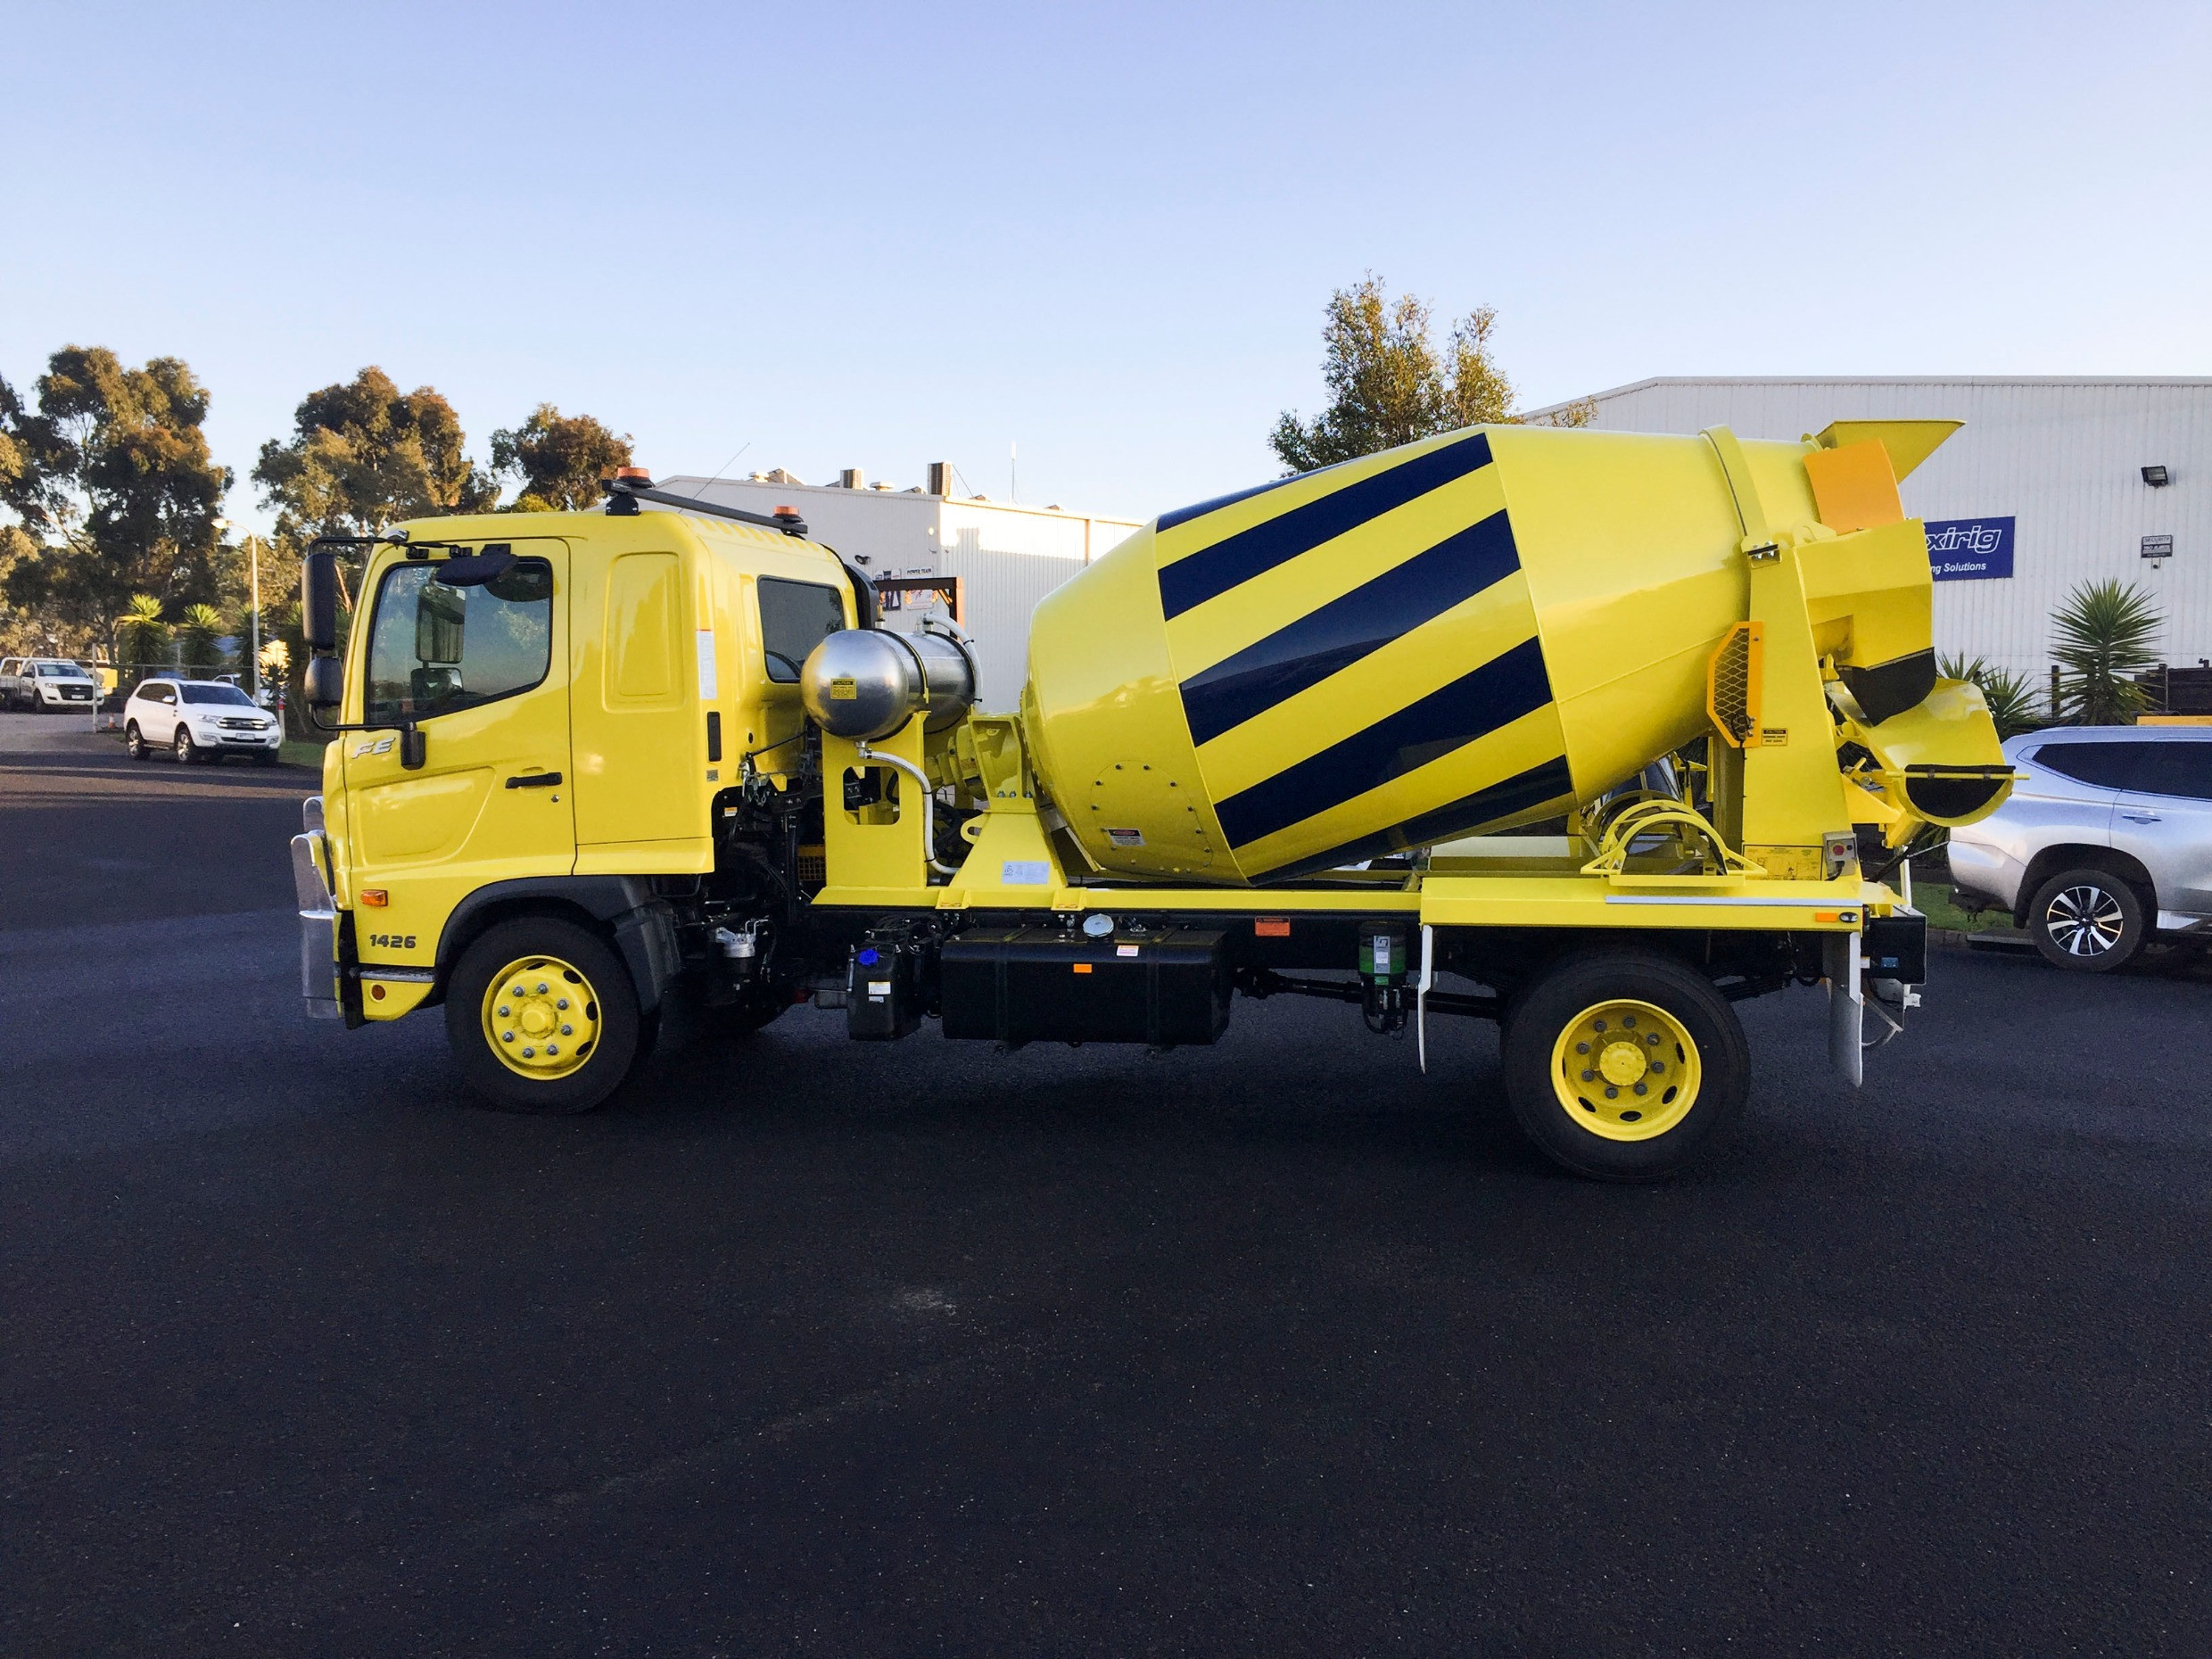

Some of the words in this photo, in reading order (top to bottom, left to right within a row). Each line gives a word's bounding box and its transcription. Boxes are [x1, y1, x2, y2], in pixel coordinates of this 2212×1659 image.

[1944, 562, 1987, 572] Solutions
[351, 738, 396, 759] FE
[369, 934, 417, 949] 1426
